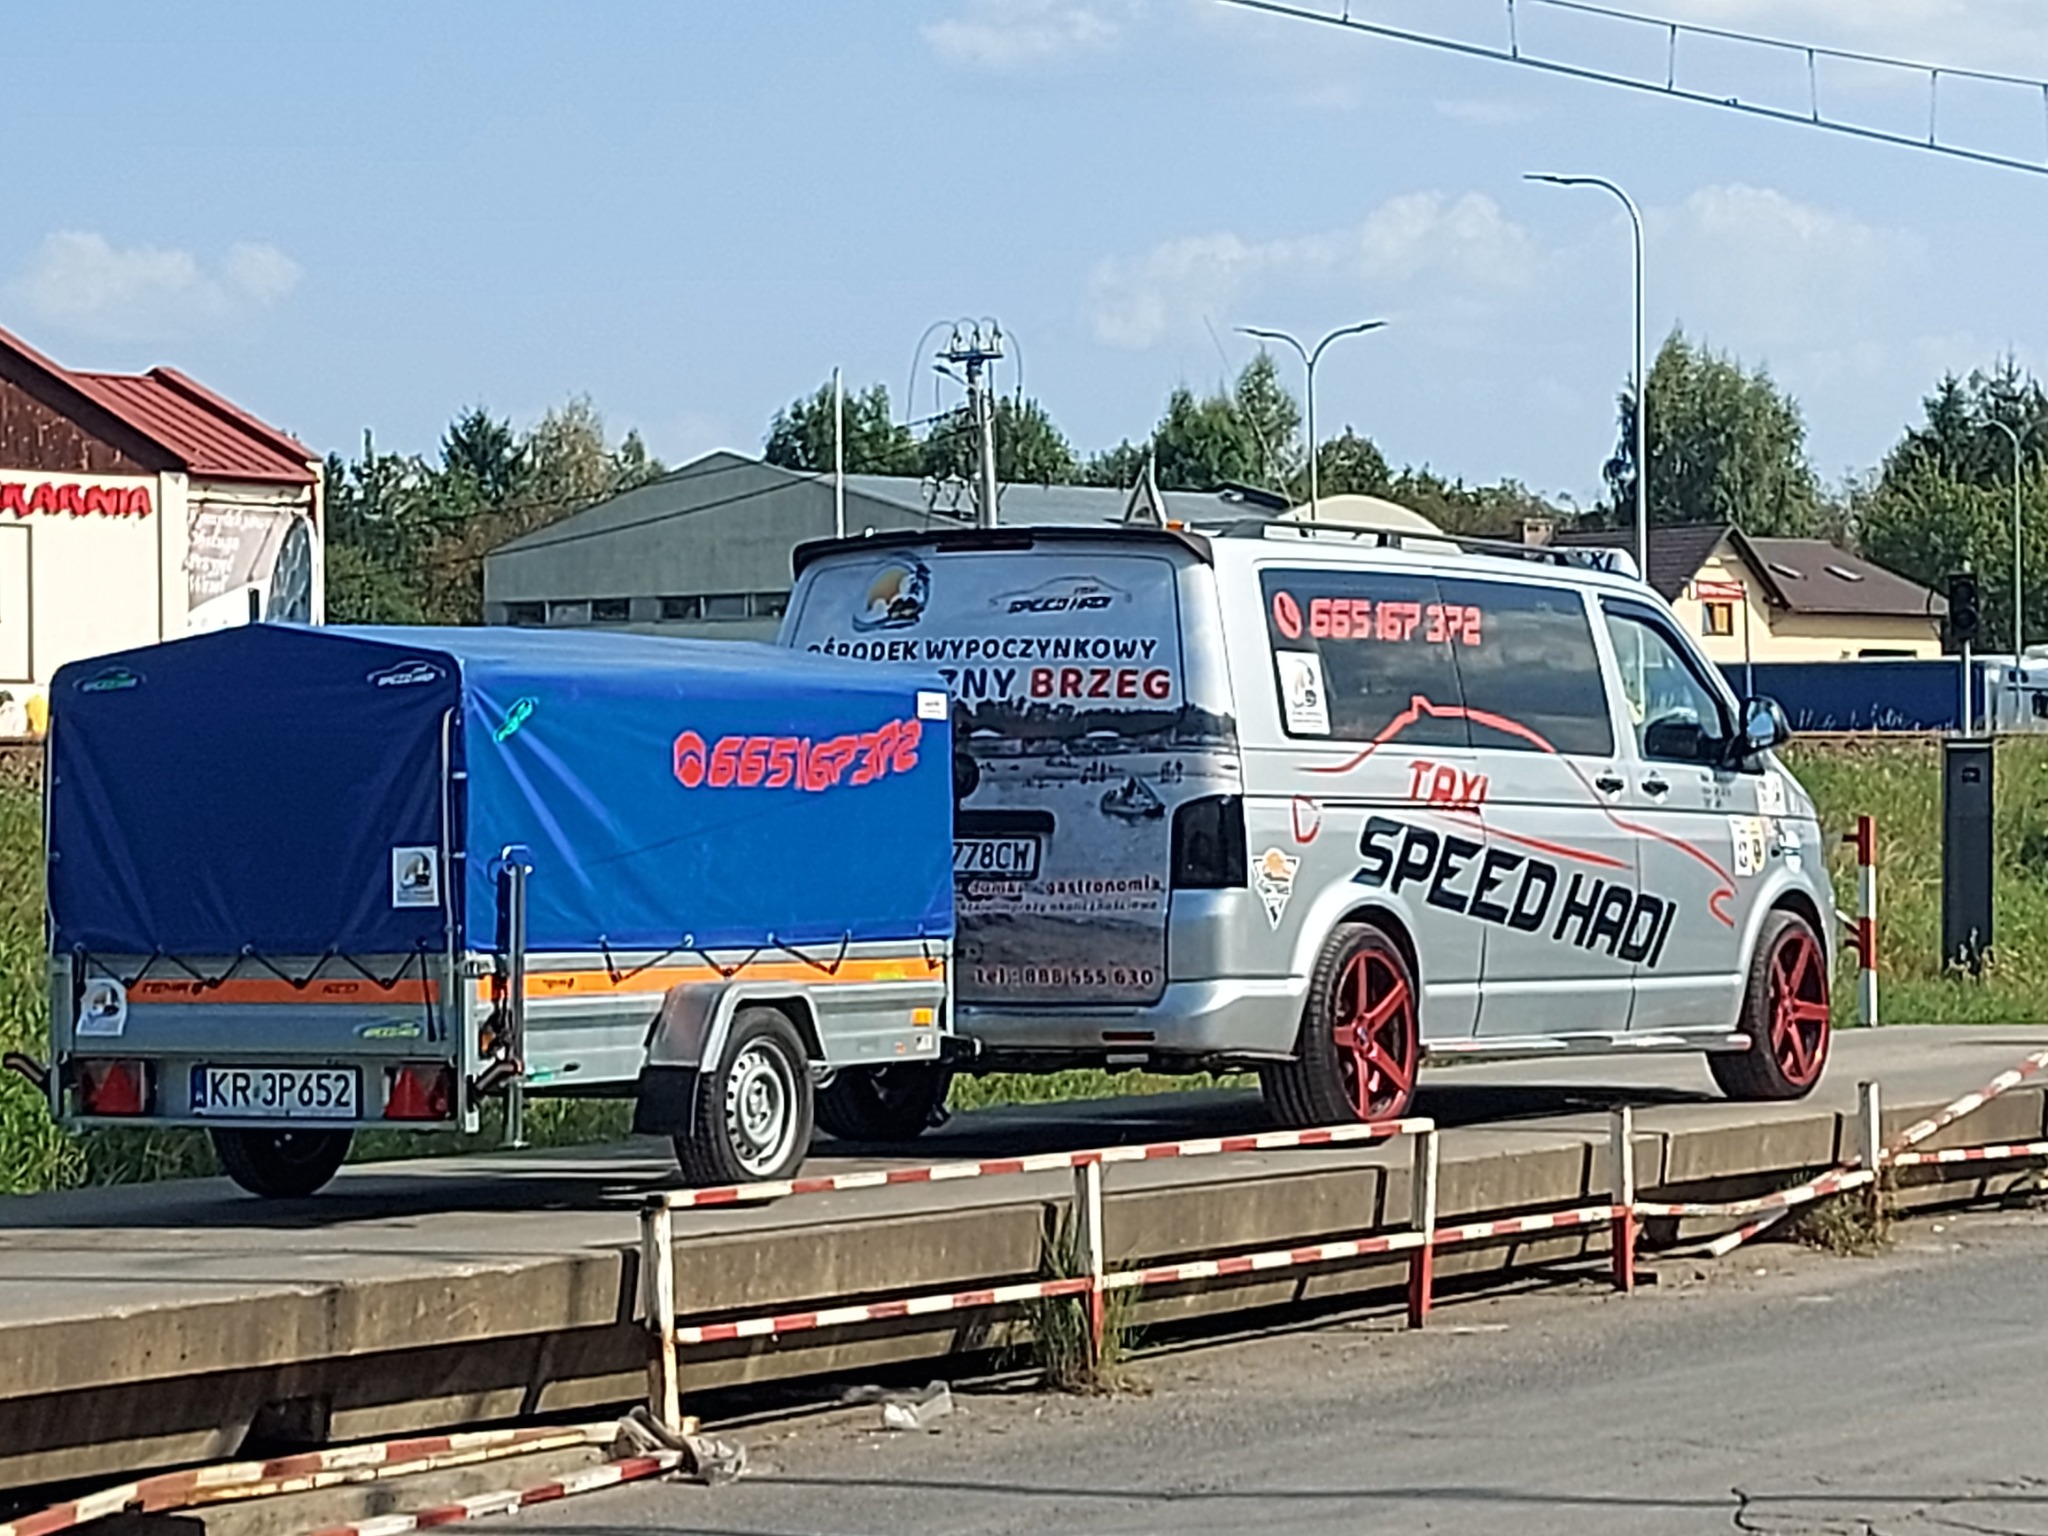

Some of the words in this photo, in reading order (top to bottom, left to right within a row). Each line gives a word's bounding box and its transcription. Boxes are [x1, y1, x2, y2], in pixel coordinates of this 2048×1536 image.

[1310, 597, 1371, 639] 665
[1375, 601, 1422, 642] 167
[1426, 604, 1482, 647] 372
[924, 637, 1158, 661] WYPOCZYNKOWY
[1030, 666, 1171, 700] BRZEG
[1408, 760, 1489, 806] TAXI
[1350, 815, 1558, 932] SPEED
[1551, 872, 1677, 969] HADI
[210, 1072, 251, 1108] KR
[261, 1072, 351, 1108] 3P652
